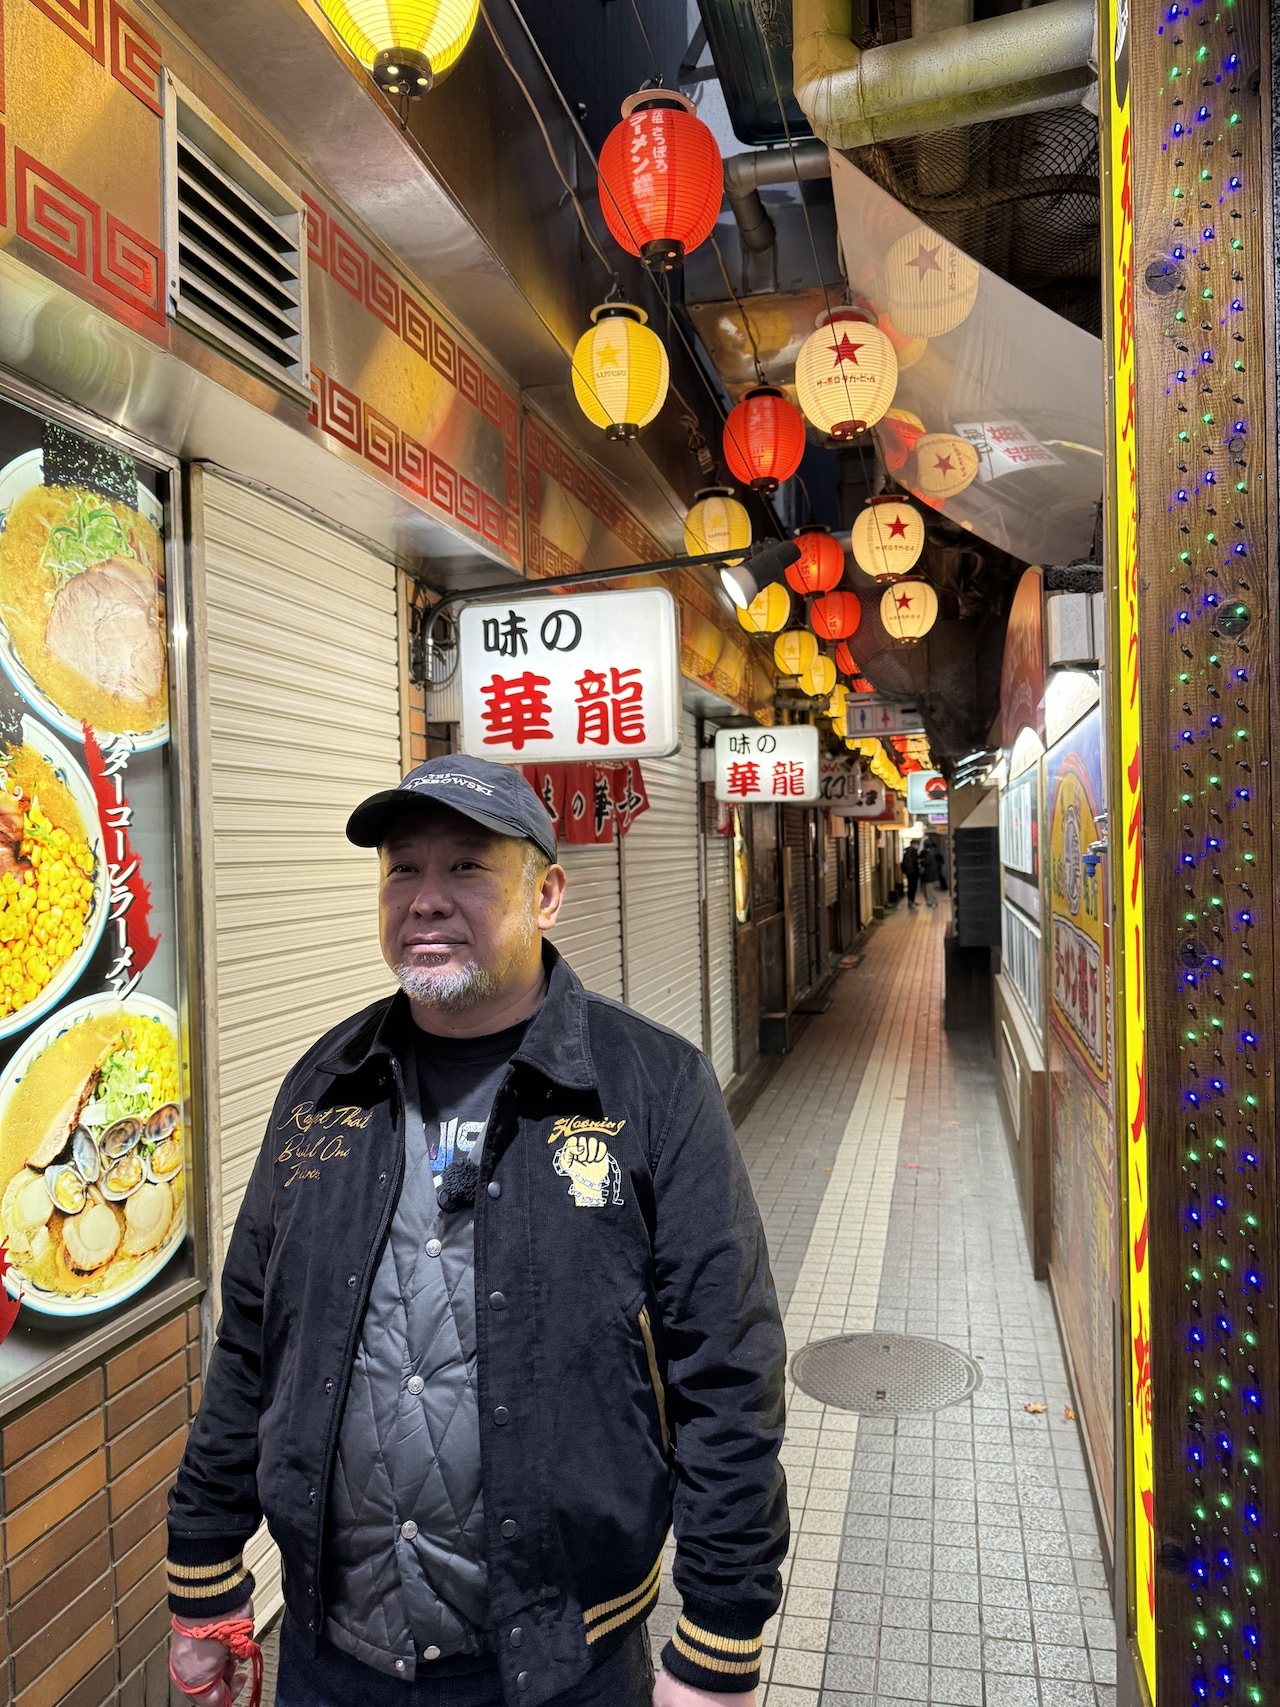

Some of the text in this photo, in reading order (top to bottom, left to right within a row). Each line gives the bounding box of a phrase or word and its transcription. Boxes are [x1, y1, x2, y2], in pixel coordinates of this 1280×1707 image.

[482, 609, 582, 658] 味の
[480, 667, 647, 751] 華龍
[729, 734, 777, 755] 味の
[726, 761, 805, 797] 華龍
[98, 730, 142, 1002] バターコーンラーメン
[322, 1106, 373, 1130] That
